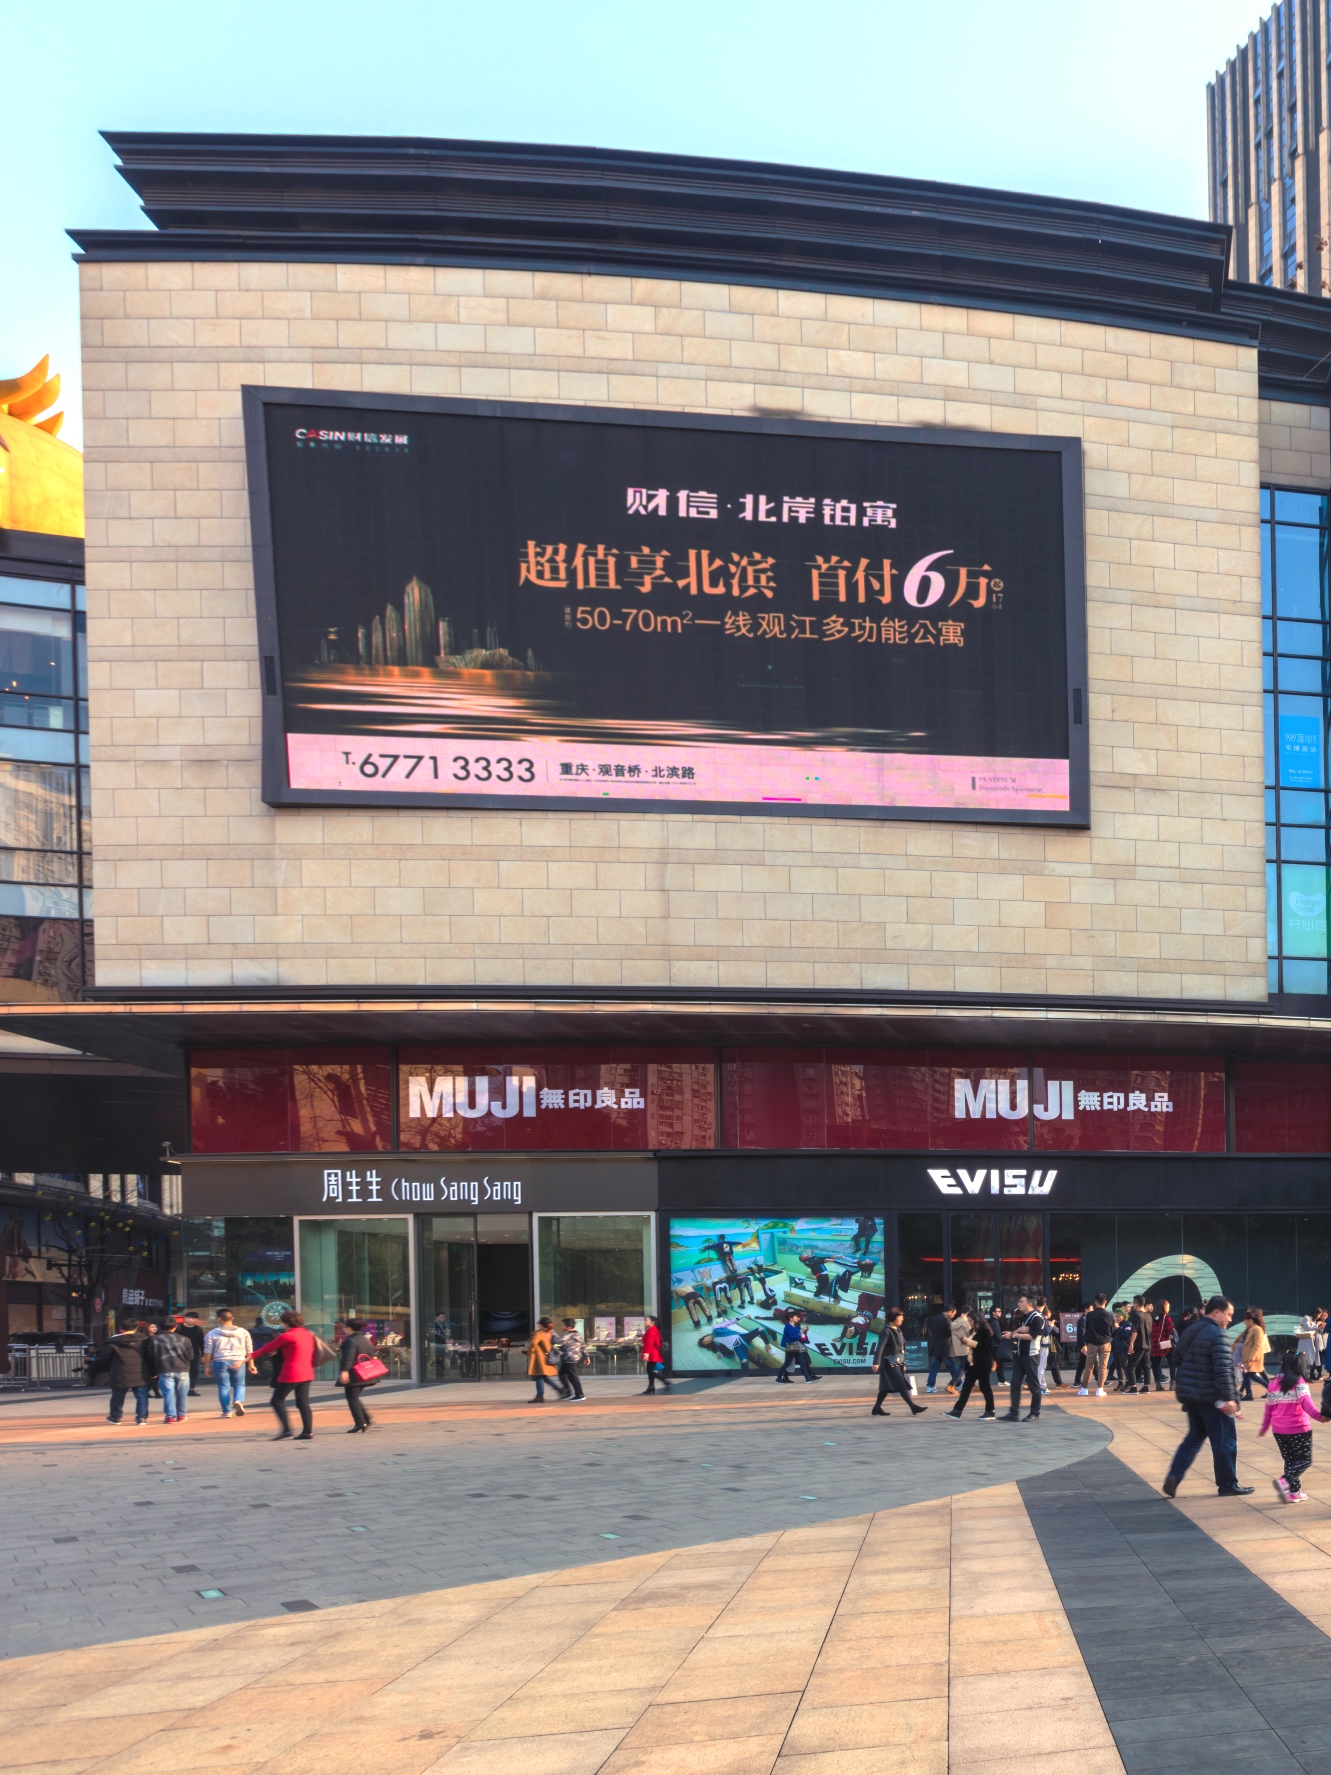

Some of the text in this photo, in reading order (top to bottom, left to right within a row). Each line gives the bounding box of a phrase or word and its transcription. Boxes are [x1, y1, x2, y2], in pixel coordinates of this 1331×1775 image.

[295, 428, 346, 441] CASIN
[518, 540, 777, 600] 超值享北滨
[408, 1075, 646, 1118] MUJI 無印良品
[953, 1078, 1173, 1120] MUJI 無印良品
[322, 1169, 522, 1205] 周生生 Chow Sang Sang
[927, 1168, 1058, 1195] EVISU
